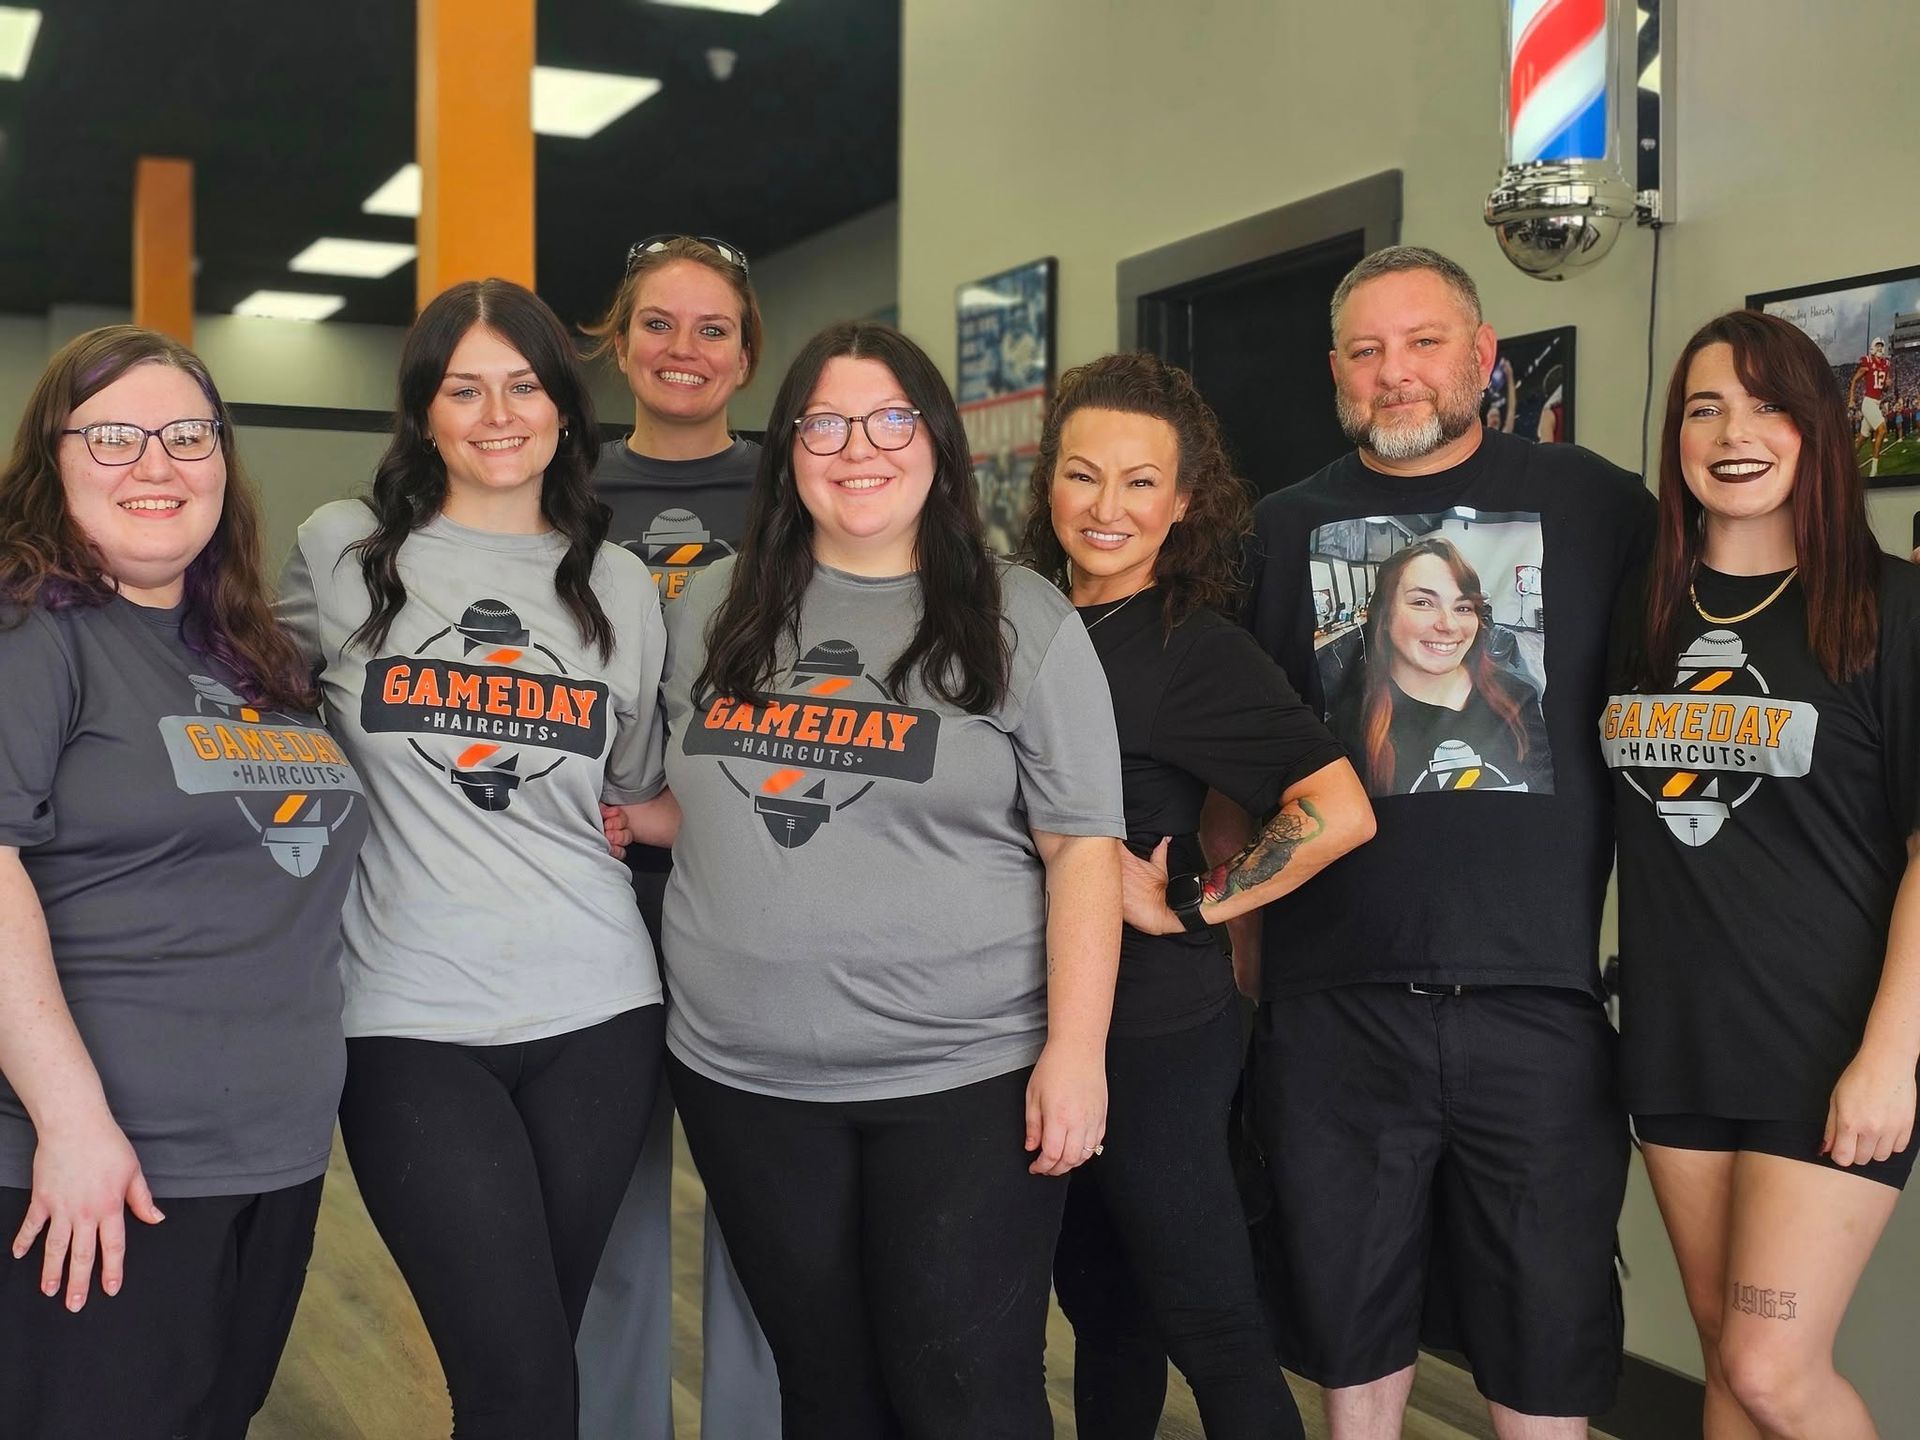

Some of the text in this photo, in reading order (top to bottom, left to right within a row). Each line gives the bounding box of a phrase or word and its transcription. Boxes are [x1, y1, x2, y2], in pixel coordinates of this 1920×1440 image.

[1873, 370, 1886, 389] 12
[382, 664, 598, 729] GAMEDAY
[703, 696, 918, 752] GAMEDAY
[1604, 702, 1793, 749] GAMEDAY
[1732, 1281, 1797, 1321] 1965
